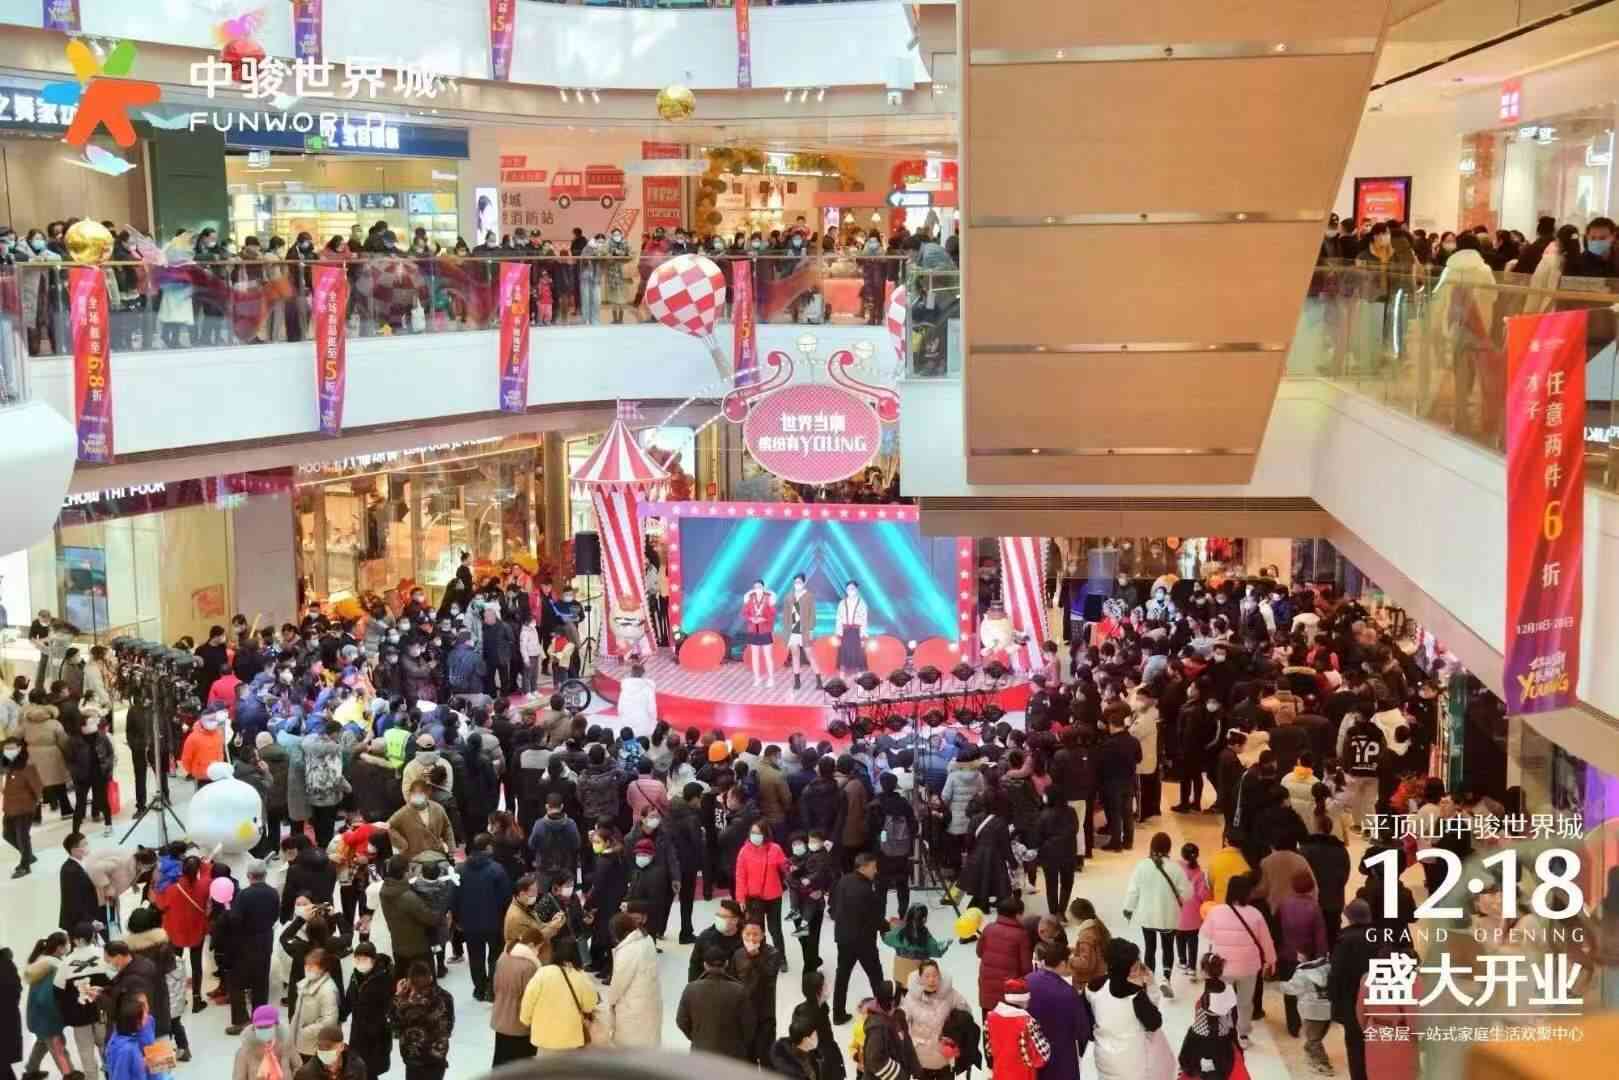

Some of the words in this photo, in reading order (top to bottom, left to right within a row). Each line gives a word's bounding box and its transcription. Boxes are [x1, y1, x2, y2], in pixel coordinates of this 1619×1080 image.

[1542, 370, 1565, 588] 任意两件6折
